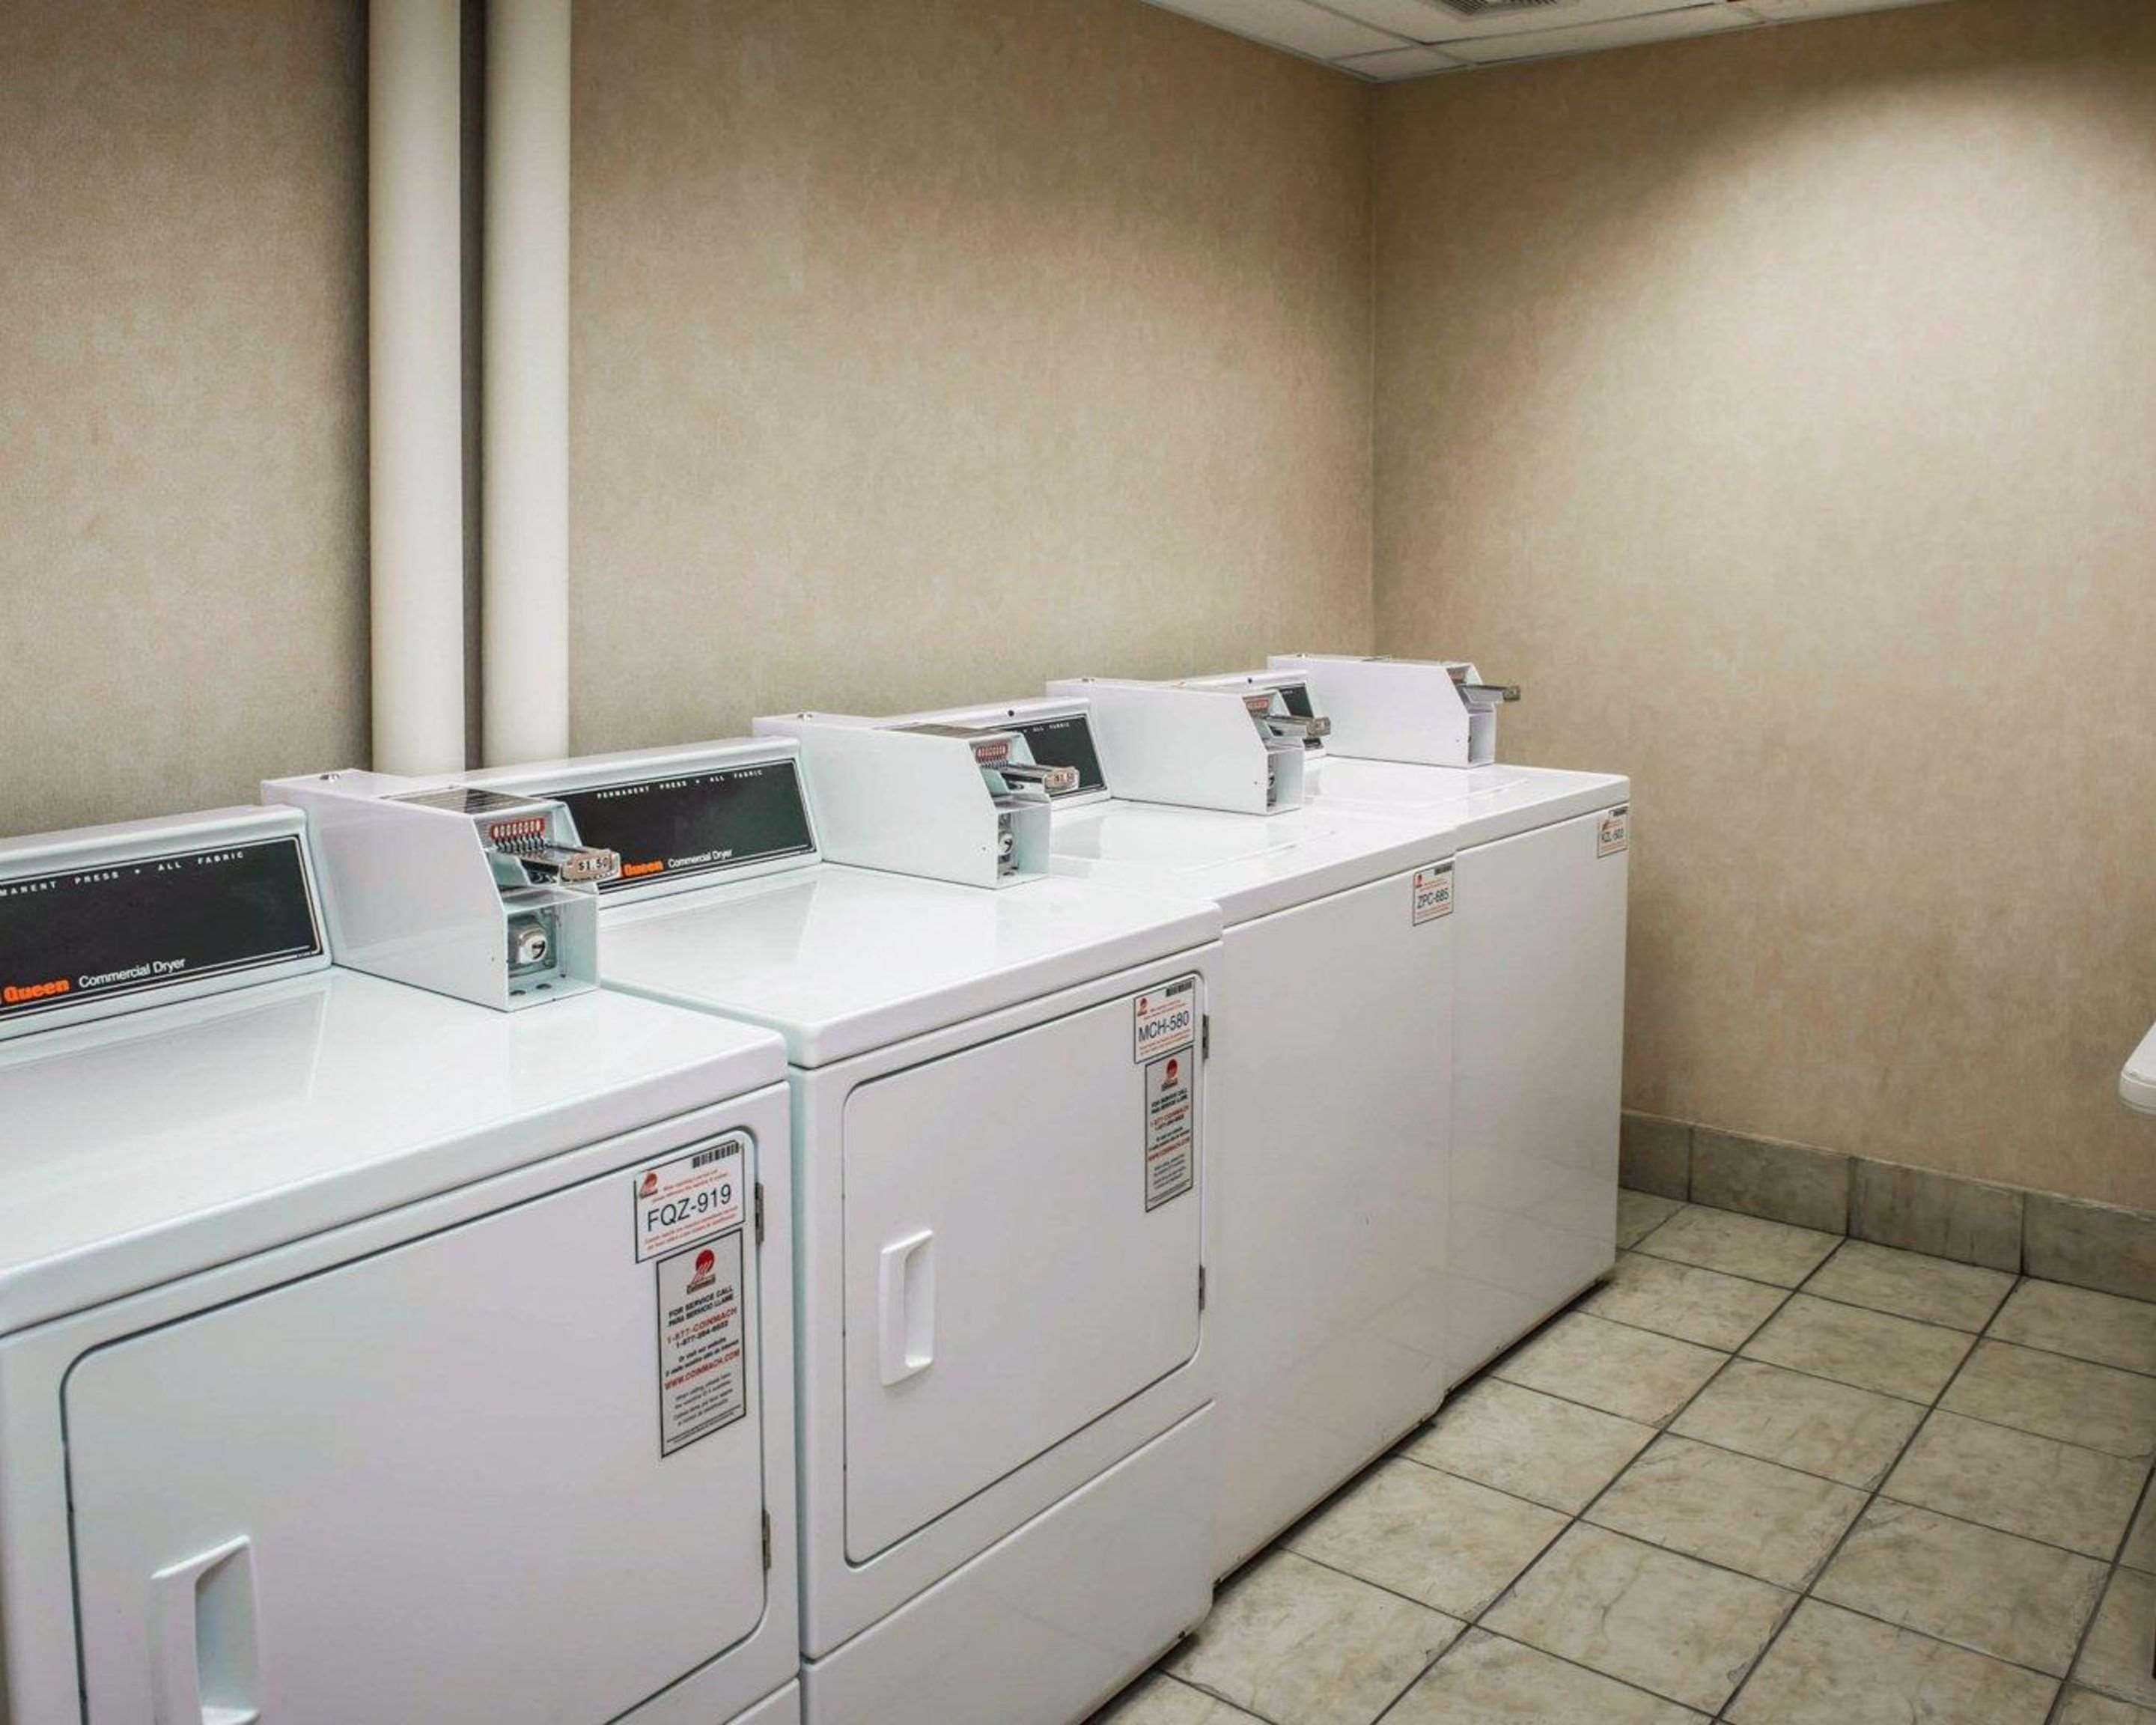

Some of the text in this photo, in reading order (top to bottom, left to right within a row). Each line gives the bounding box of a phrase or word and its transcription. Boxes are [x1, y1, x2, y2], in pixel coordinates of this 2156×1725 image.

[659, 779, 687, 791] PRESS
[734, 769, 763, 779] FABRIC
[74, 871, 120, 885] PRESS
[158, 861, 182, 871] ALL
[198, 851, 244, 865] FABRIC
[668, 852, 711, 868] Commercial
[712, 849, 733, 861] Dryer
[3, 958, 186, 1003] Queen Commercial Dryer
[1138, 1009, 1190, 1042] MCH-580
[647, 1183, 732, 1232] FQZ-919
[669, 1285, 734, 1318] FOR SERVICE CALL
